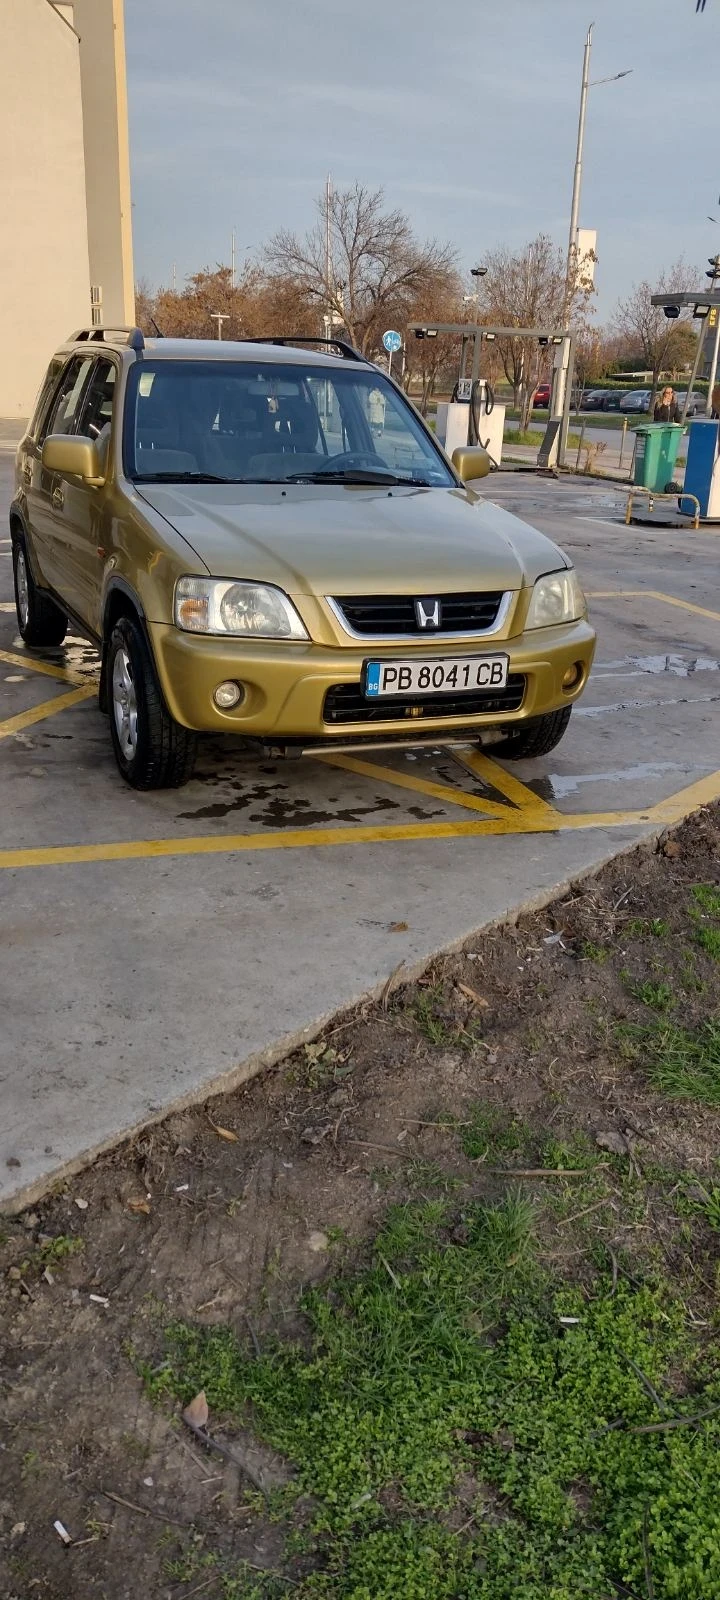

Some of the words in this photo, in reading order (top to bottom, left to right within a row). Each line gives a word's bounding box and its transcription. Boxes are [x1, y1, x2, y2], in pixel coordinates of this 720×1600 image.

[382, 667, 412, 690] PB
[418, 664, 470, 688] 8041
[476, 662, 504, 686] CB
[368, 683, 379, 691] BG
